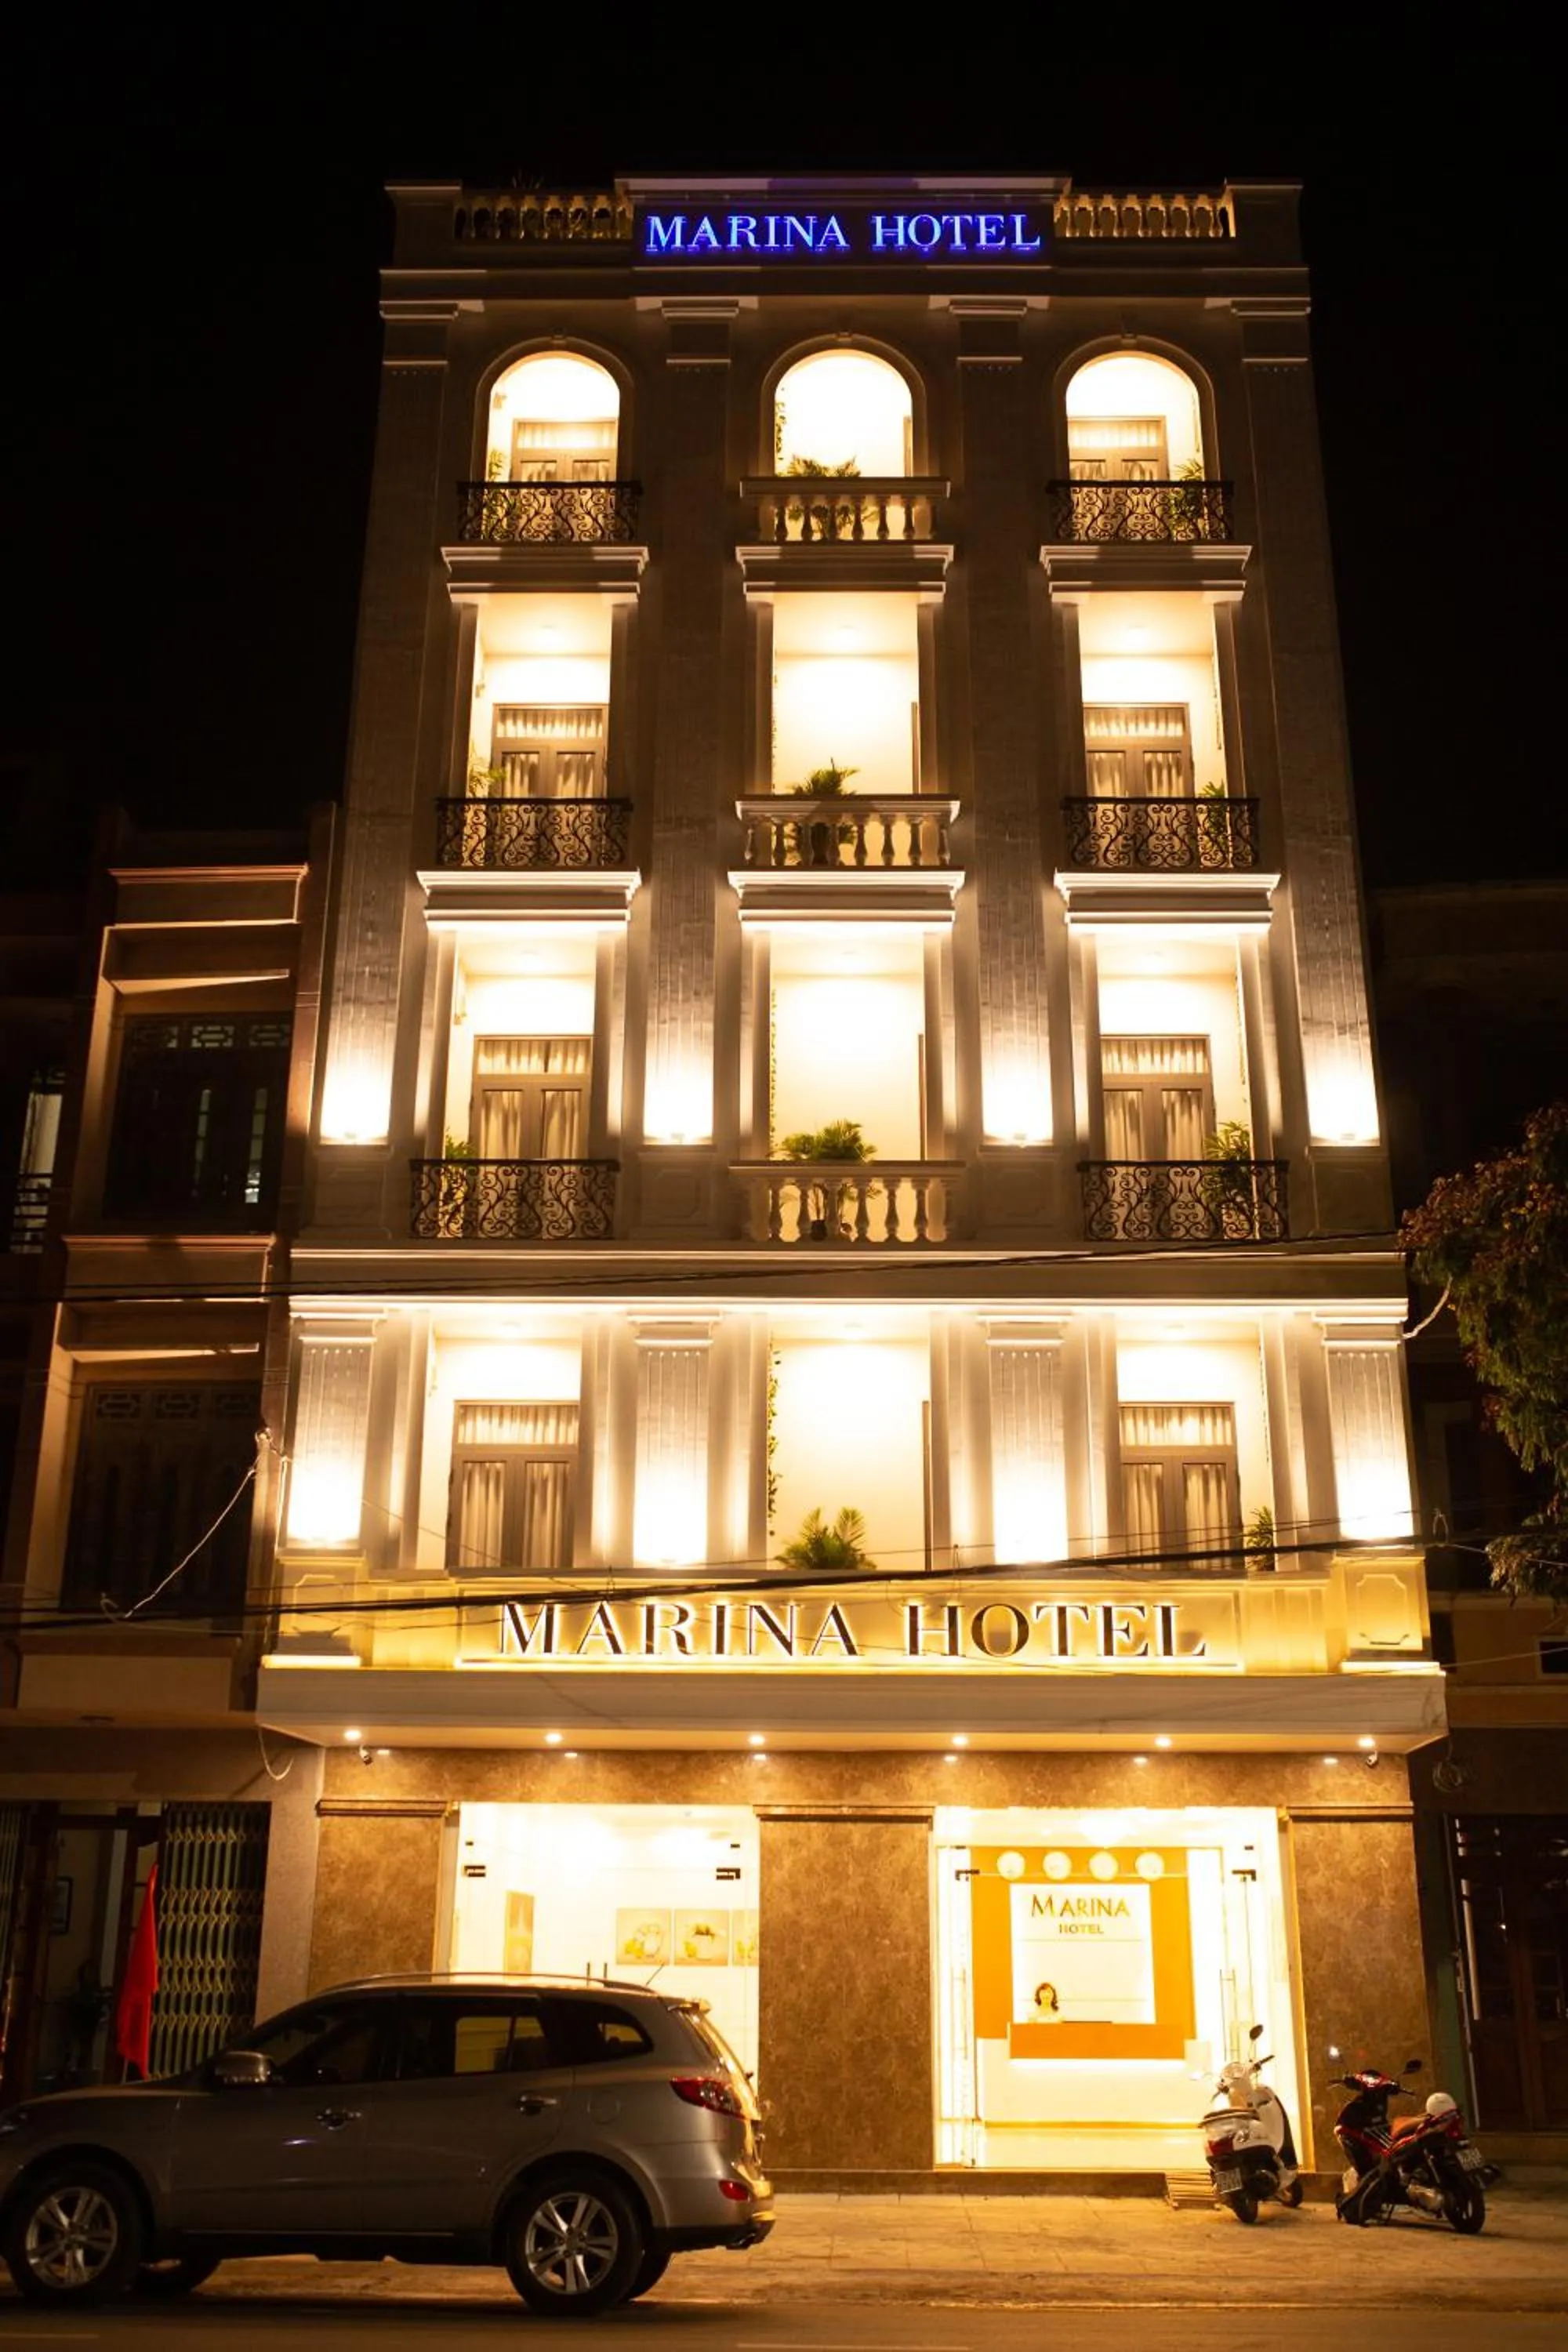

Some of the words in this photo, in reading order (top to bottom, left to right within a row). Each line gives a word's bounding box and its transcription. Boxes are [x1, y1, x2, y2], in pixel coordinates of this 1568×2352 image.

[646, 215, 851, 251] MARINA
[871, 214, 1042, 250] HOTEL
[499, 1602, 865, 1657] MARINA
[902, 1603, 1207, 1657] HOTEL
[1031, 1893, 1131, 1918] MARINA
[1058, 1923, 1104, 1934] HOTEL
